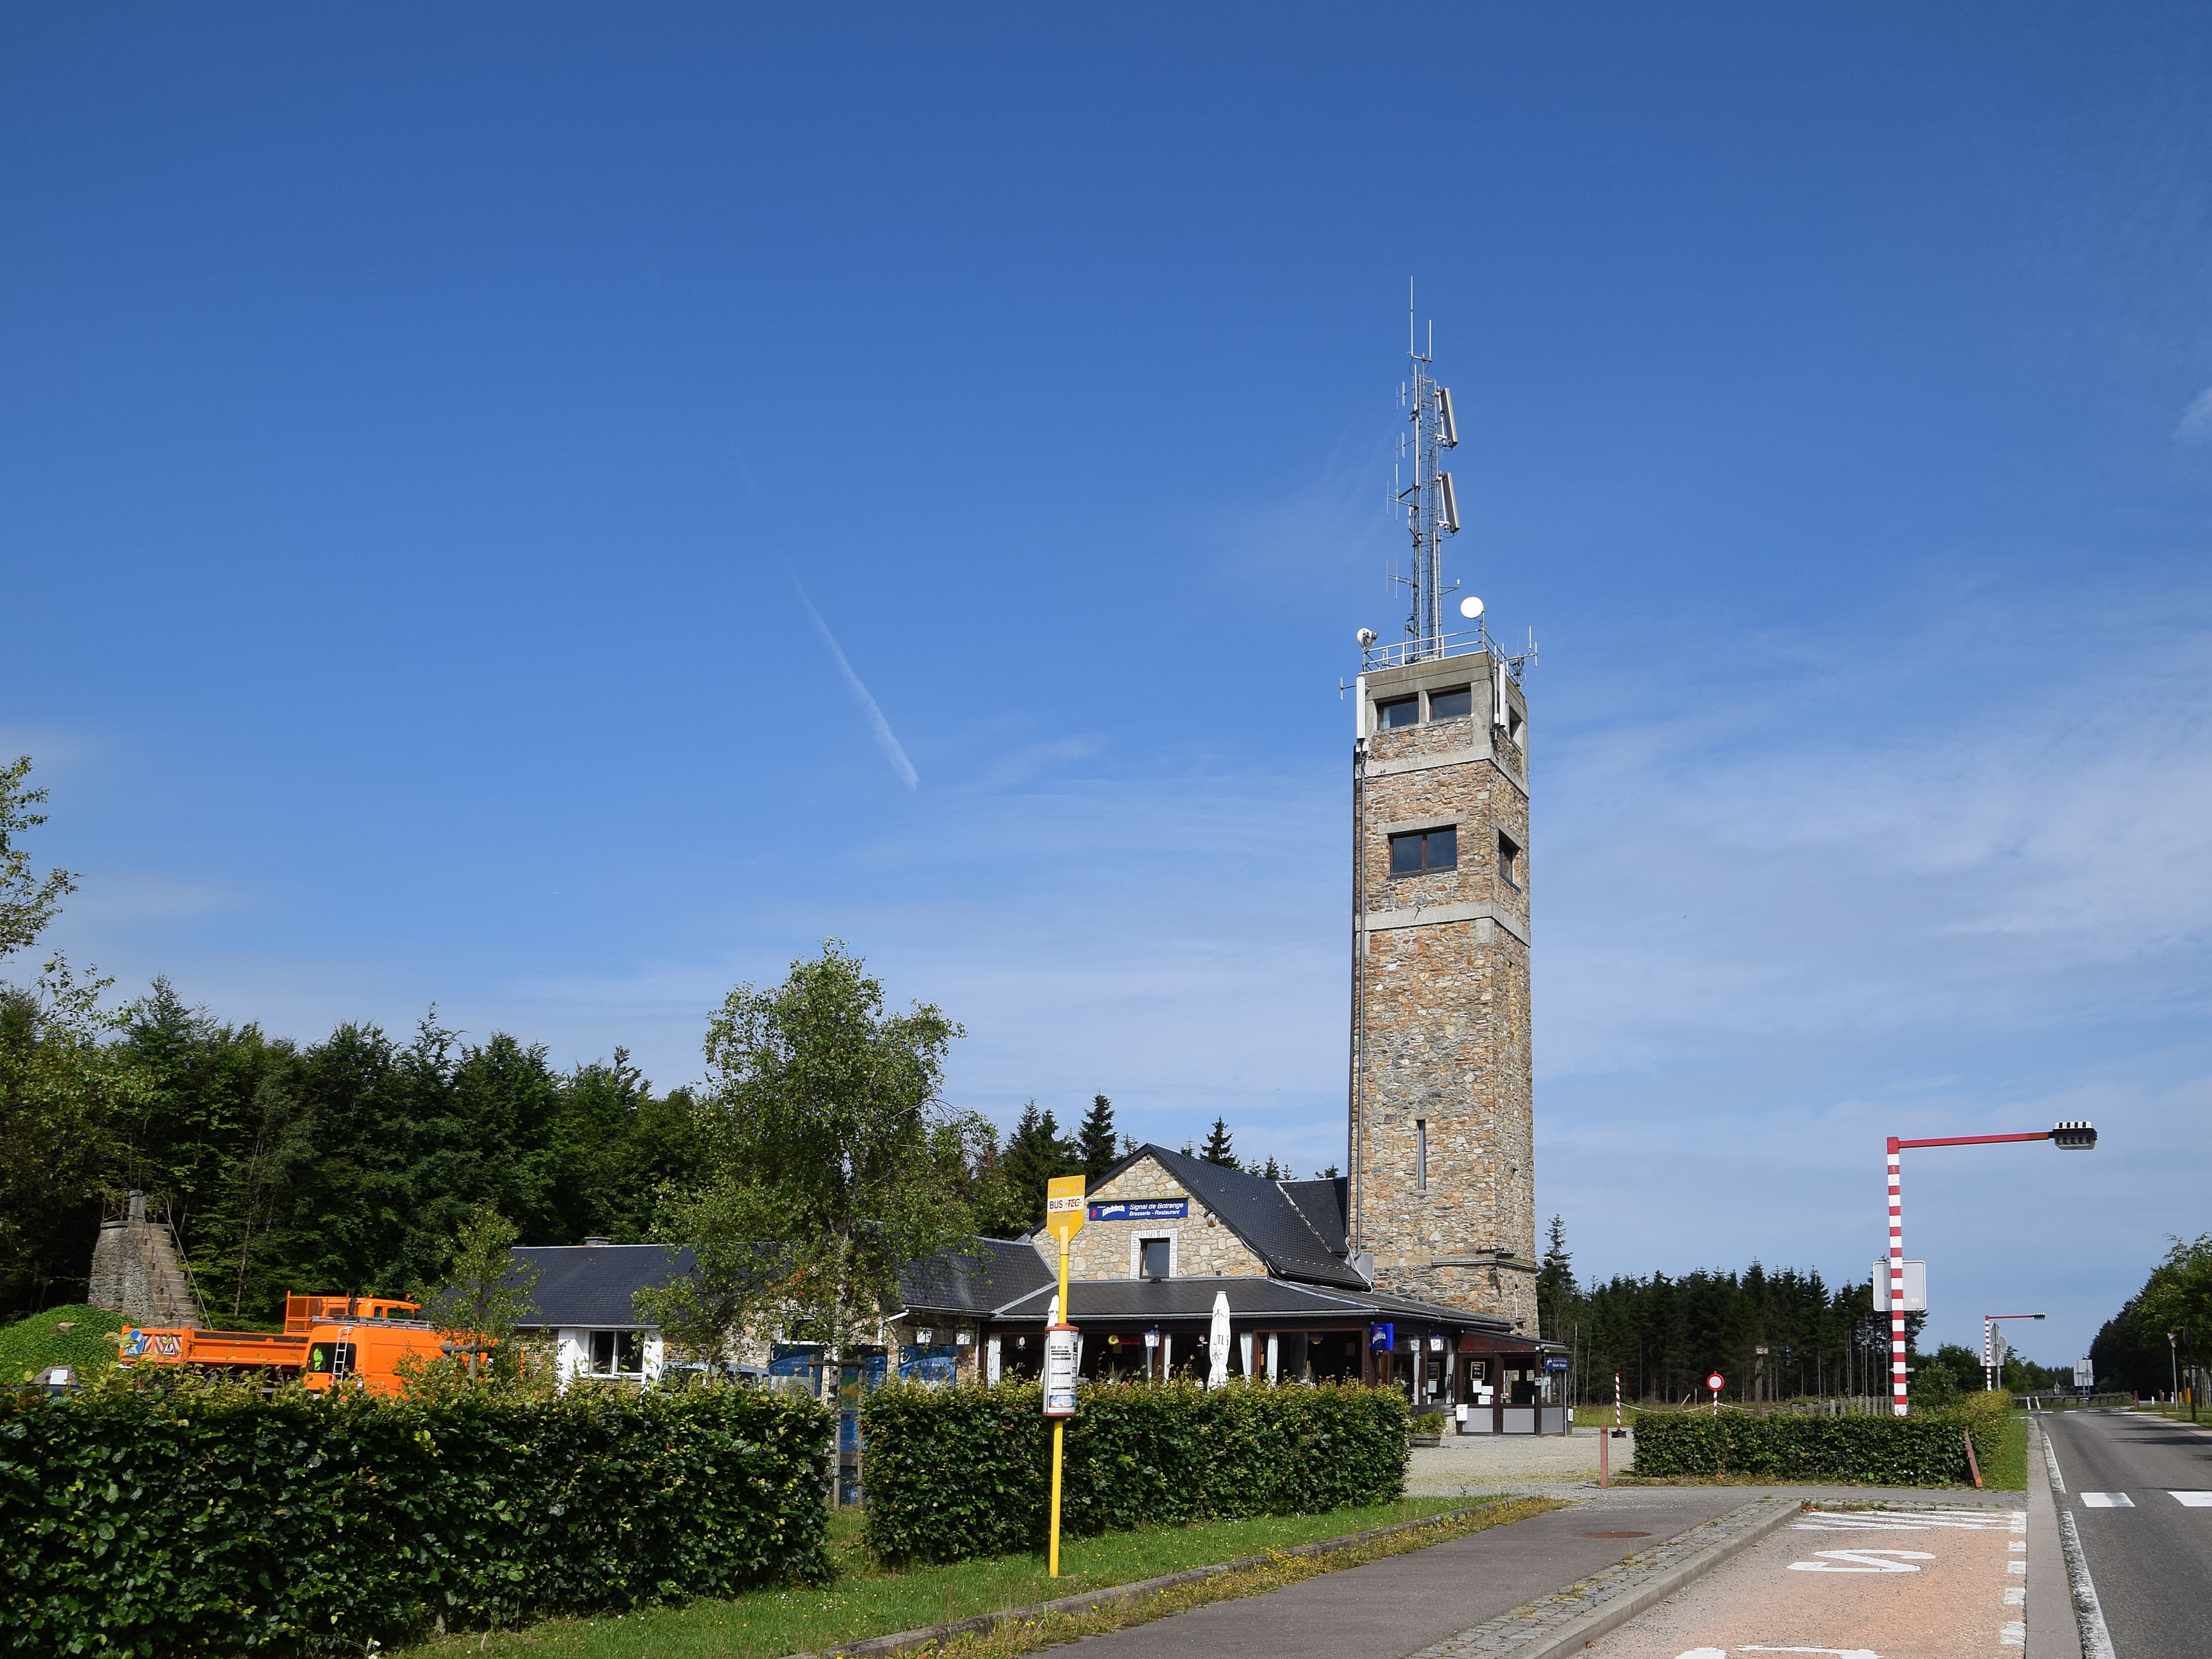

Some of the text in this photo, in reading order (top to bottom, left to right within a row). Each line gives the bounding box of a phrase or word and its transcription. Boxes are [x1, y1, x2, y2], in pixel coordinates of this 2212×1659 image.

[1050, 1198, 1081, 1210] BUS TEC
[1130, 1203, 1148, 1211] Signal
